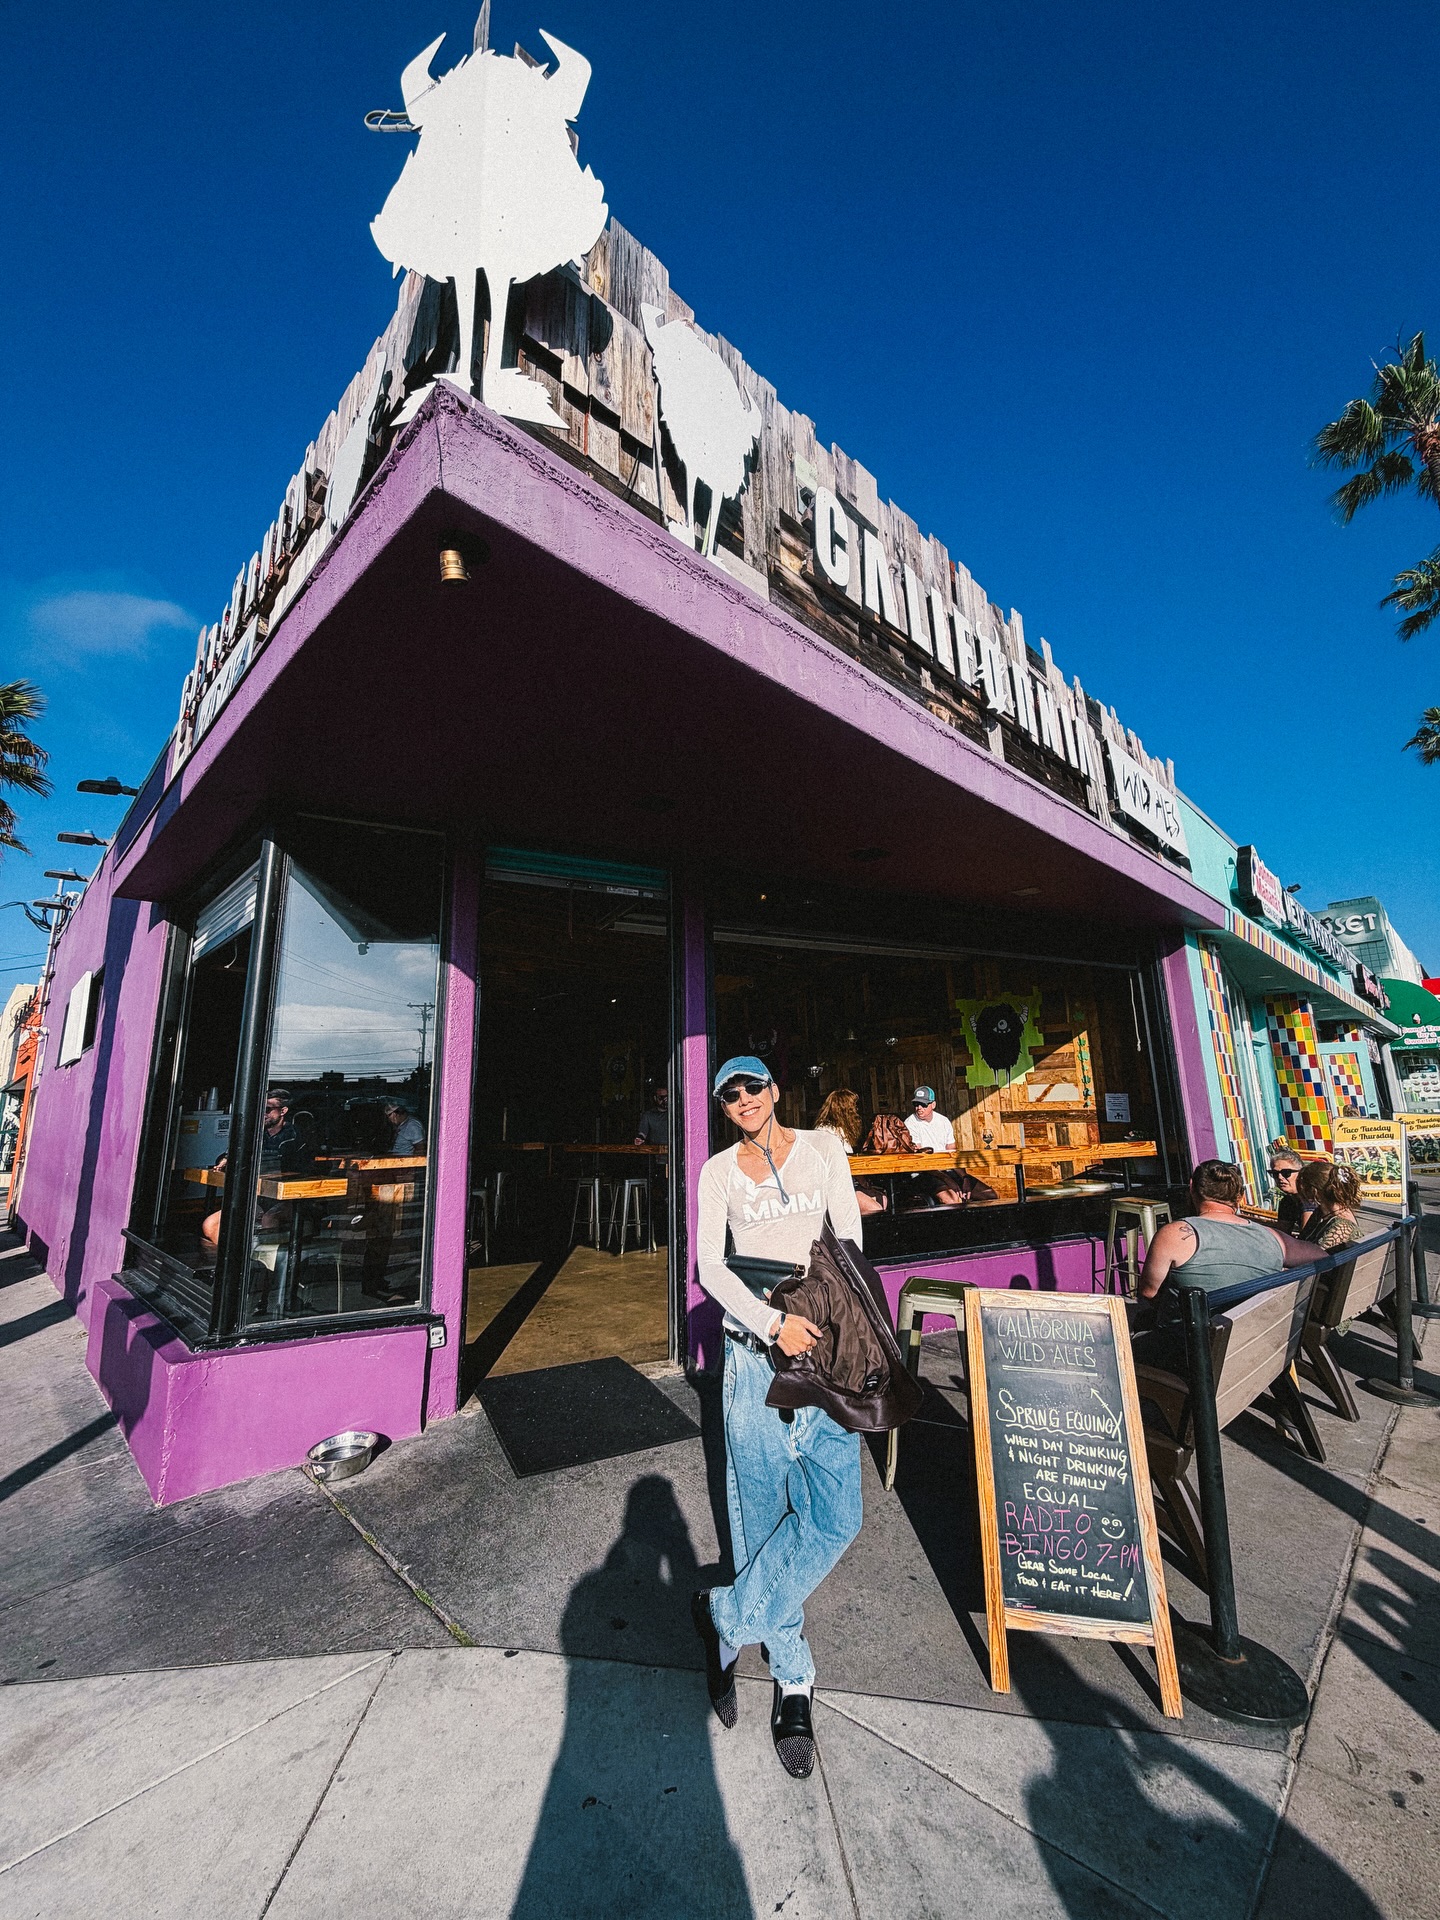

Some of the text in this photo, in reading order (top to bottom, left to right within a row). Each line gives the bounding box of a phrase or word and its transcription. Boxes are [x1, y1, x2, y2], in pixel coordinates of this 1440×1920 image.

[1359, 1132, 1394, 1140] Thursday
[742, 1189, 822, 1222] MMM
[997, 1313, 1095, 1343] CALIFORNIA
[999, 1340, 1097, 1368] WILD ALES
[995, 1389, 1123, 1444] SPRING EQUINOX
[1004, 1434, 1128, 1468] WHEN DAY DRINKING
[1018, 1448, 1060, 1469] NIGHT
[1066, 1457, 1128, 1485] DRINKING
[1036, 1469, 1107, 1491] ARE FINALLY
[1023, 1482, 1098, 1511] EQUAL
[1004, 1501, 1092, 1535] RADIO
[1004, 1533, 1088, 1560] BINGO
[1075, 1586, 1088, 1595] IT
